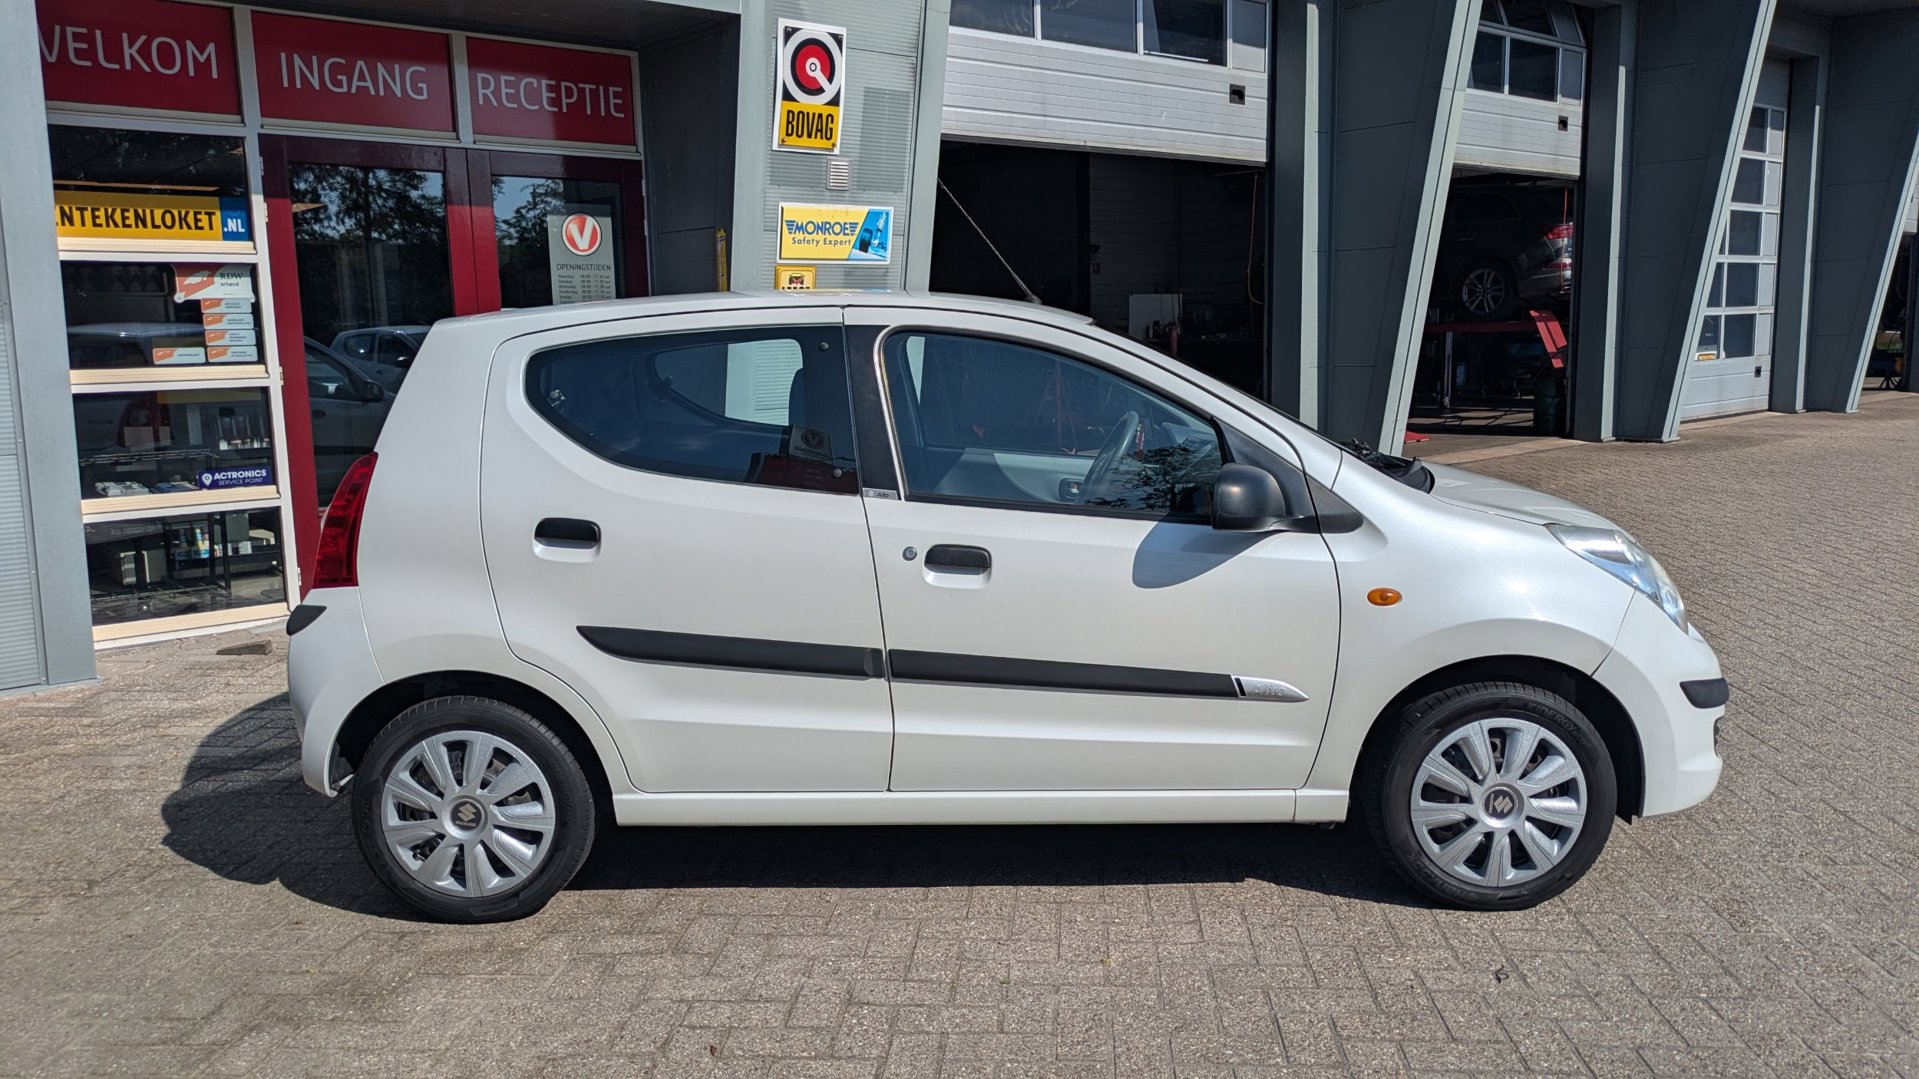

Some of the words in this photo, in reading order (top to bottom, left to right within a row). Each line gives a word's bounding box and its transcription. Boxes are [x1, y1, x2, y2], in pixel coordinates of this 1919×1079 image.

[280, 52, 429, 100] INGANG
[476, 72, 626, 119] RECEPTIE
[785, 109, 835, 141] BOVAG
[55, 206, 216, 231] NTEKENLOKET
[223, 218, 246, 233] .NL
[793, 220, 850, 237] MONROE
[791, 237, 821, 247] Safety
[823, 237, 852, 248] Expert
[220, 271, 243, 280] RDW
[556, 263, 612, 272] OPENINGSTIJDEN
[213, 469, 267, 480] ACTRONICS
